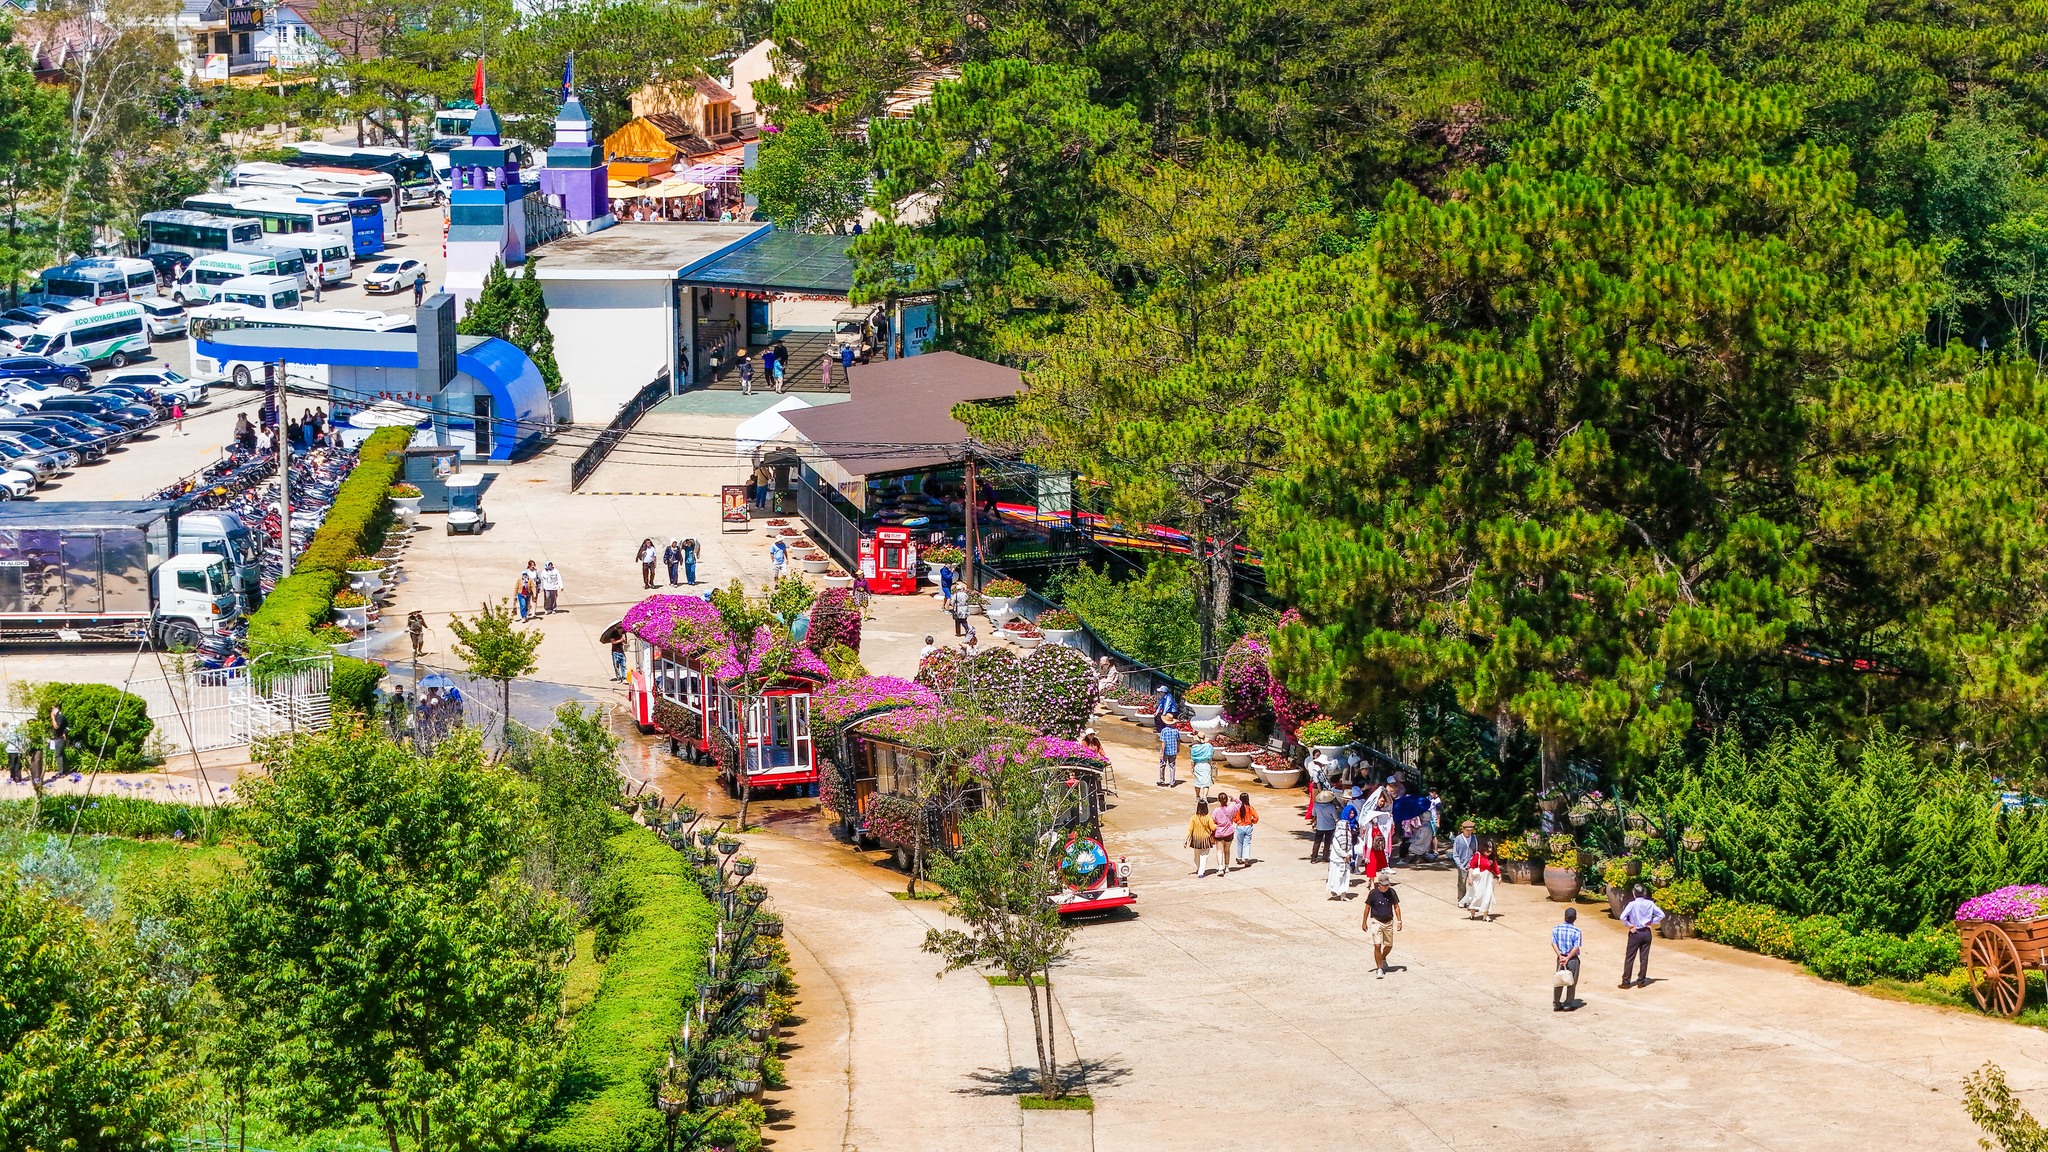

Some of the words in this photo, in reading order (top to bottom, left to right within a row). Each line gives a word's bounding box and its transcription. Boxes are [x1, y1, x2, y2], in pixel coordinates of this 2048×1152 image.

[230, 10, 253, 25] HANA
[75, 317, 89, 326] ECO
[90, 312, 115, 323] VOYAGE
[116, 308, 137, 318] TRAVEL
